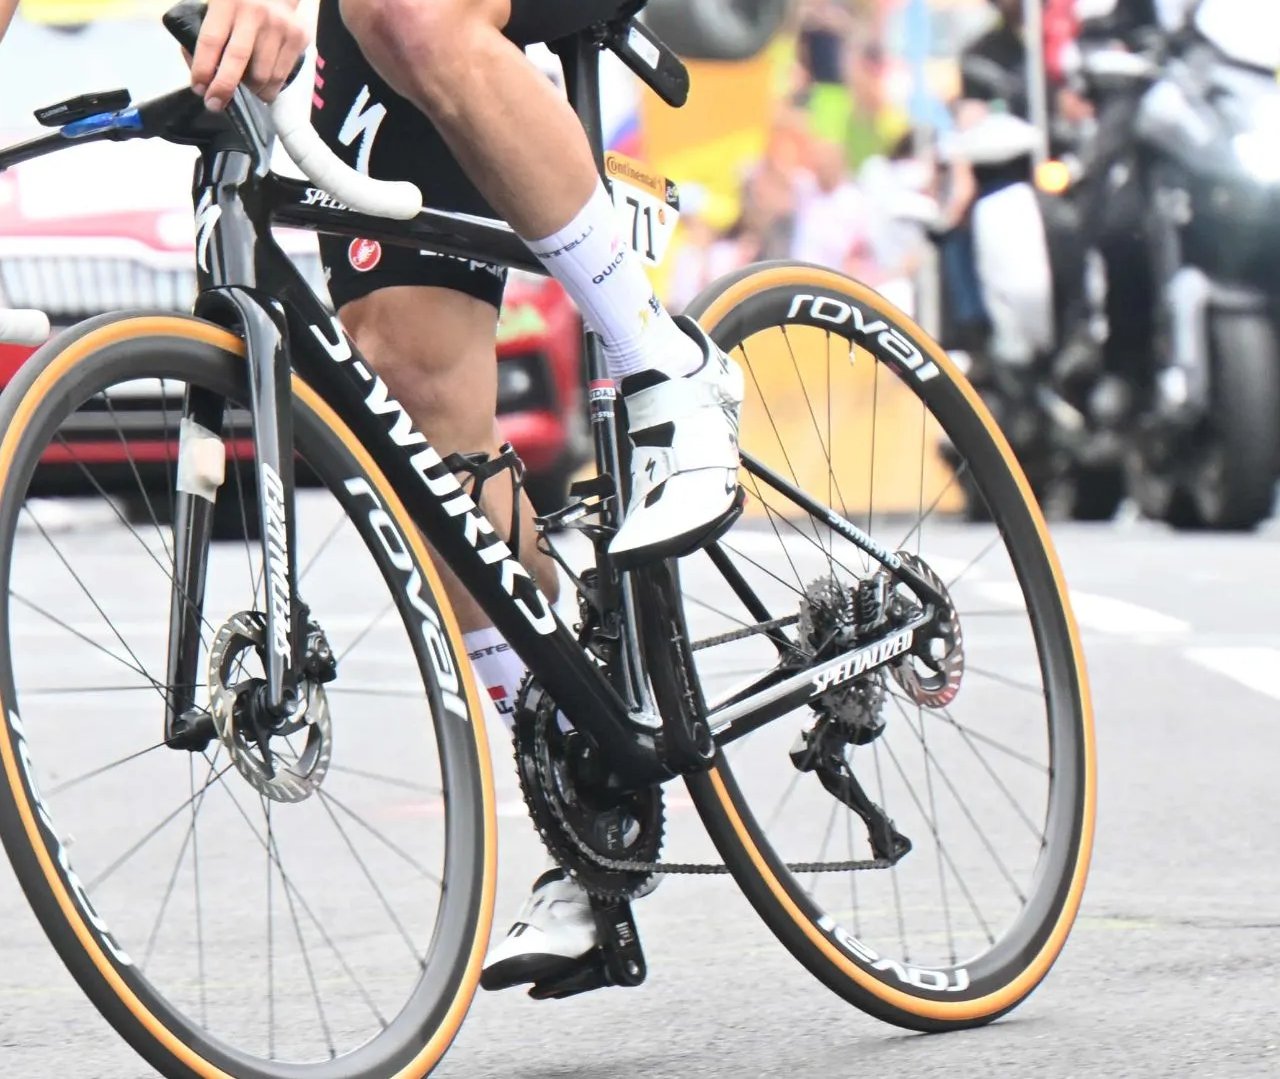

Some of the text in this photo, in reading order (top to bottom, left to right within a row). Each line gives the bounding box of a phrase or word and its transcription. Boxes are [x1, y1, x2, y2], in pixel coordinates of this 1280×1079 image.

[626, 196, 657, 262] 71
[786, 294, 941, 383] roval
[309, 316, 557, 636] S-WORKS
[262, 462, 292, 670] SPECIALIZED
[343, 476, 469, 722] roval
[809, 629, 914, 696] SPECIALIZED
